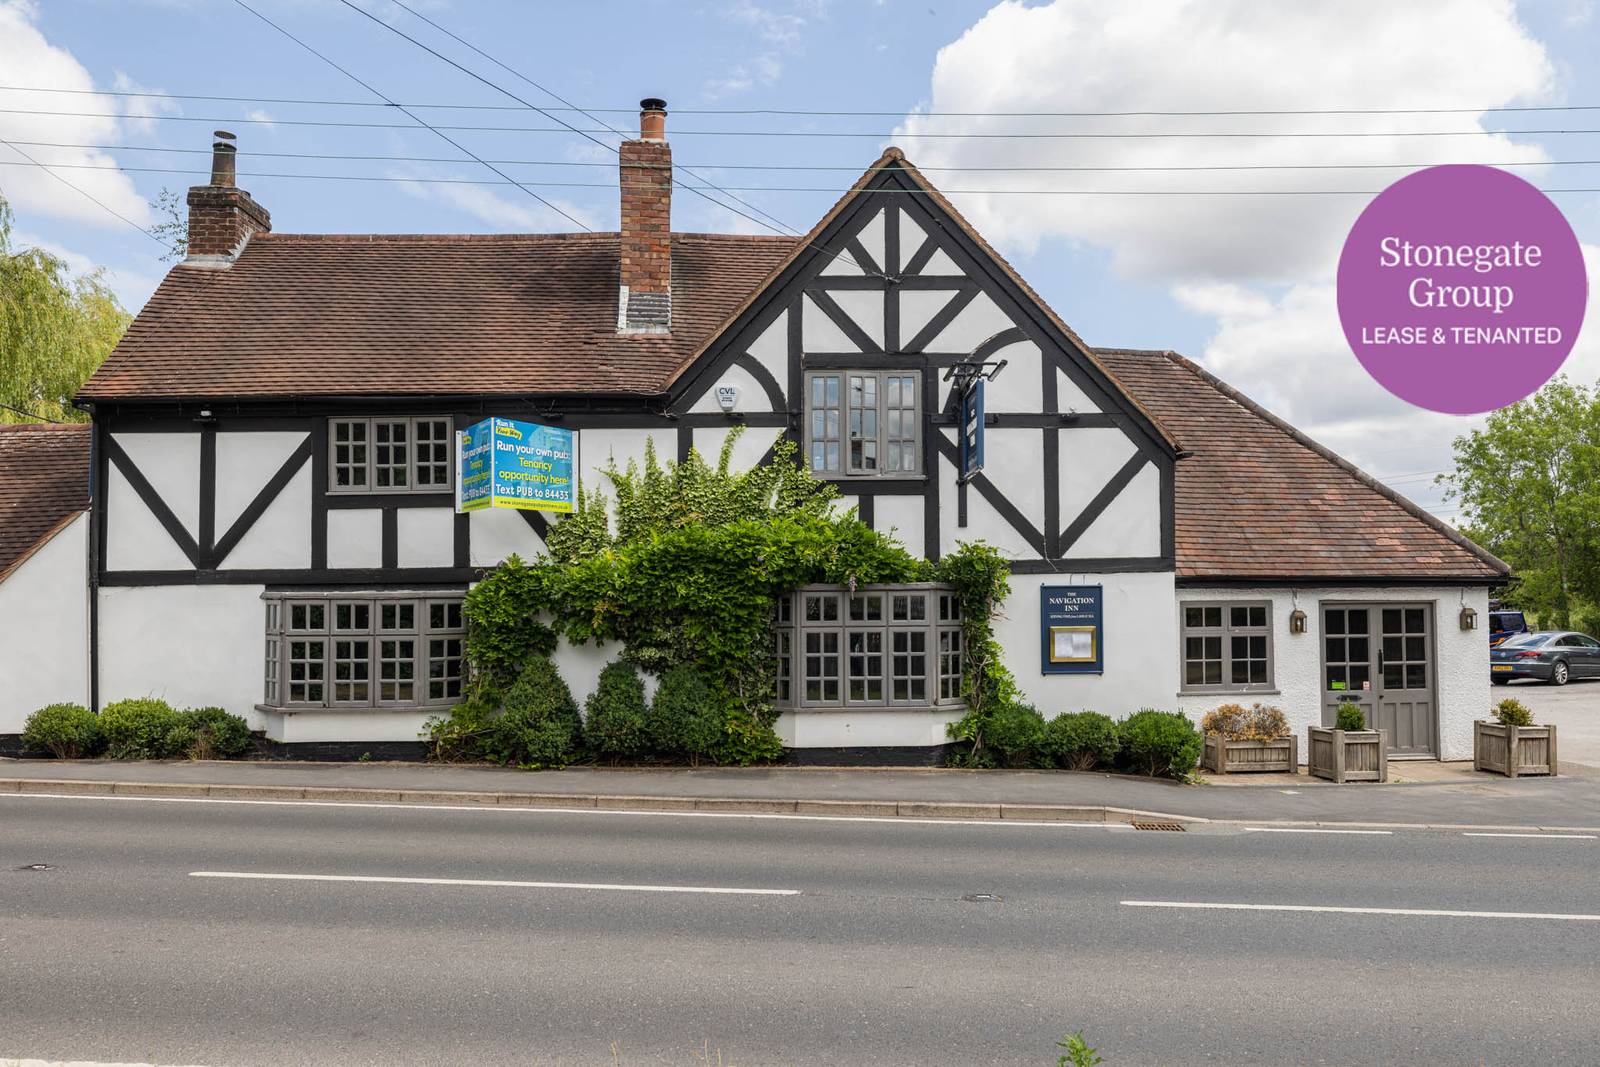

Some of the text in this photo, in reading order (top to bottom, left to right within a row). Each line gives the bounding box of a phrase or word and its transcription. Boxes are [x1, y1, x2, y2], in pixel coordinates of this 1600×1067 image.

[496, 440, 514, 452] Run
[516, 445, 535, 456] your
[536, 448, 552, 456] own
[519, 458, 552, 472] Tenancy
[499, 470, 548, 484] opportunity
[496, 484, 514, 494] Text
[516, 486, 533, 497] PUB
[535, 488, 543, 497] to
[545, 490, 568, 500] 84433
